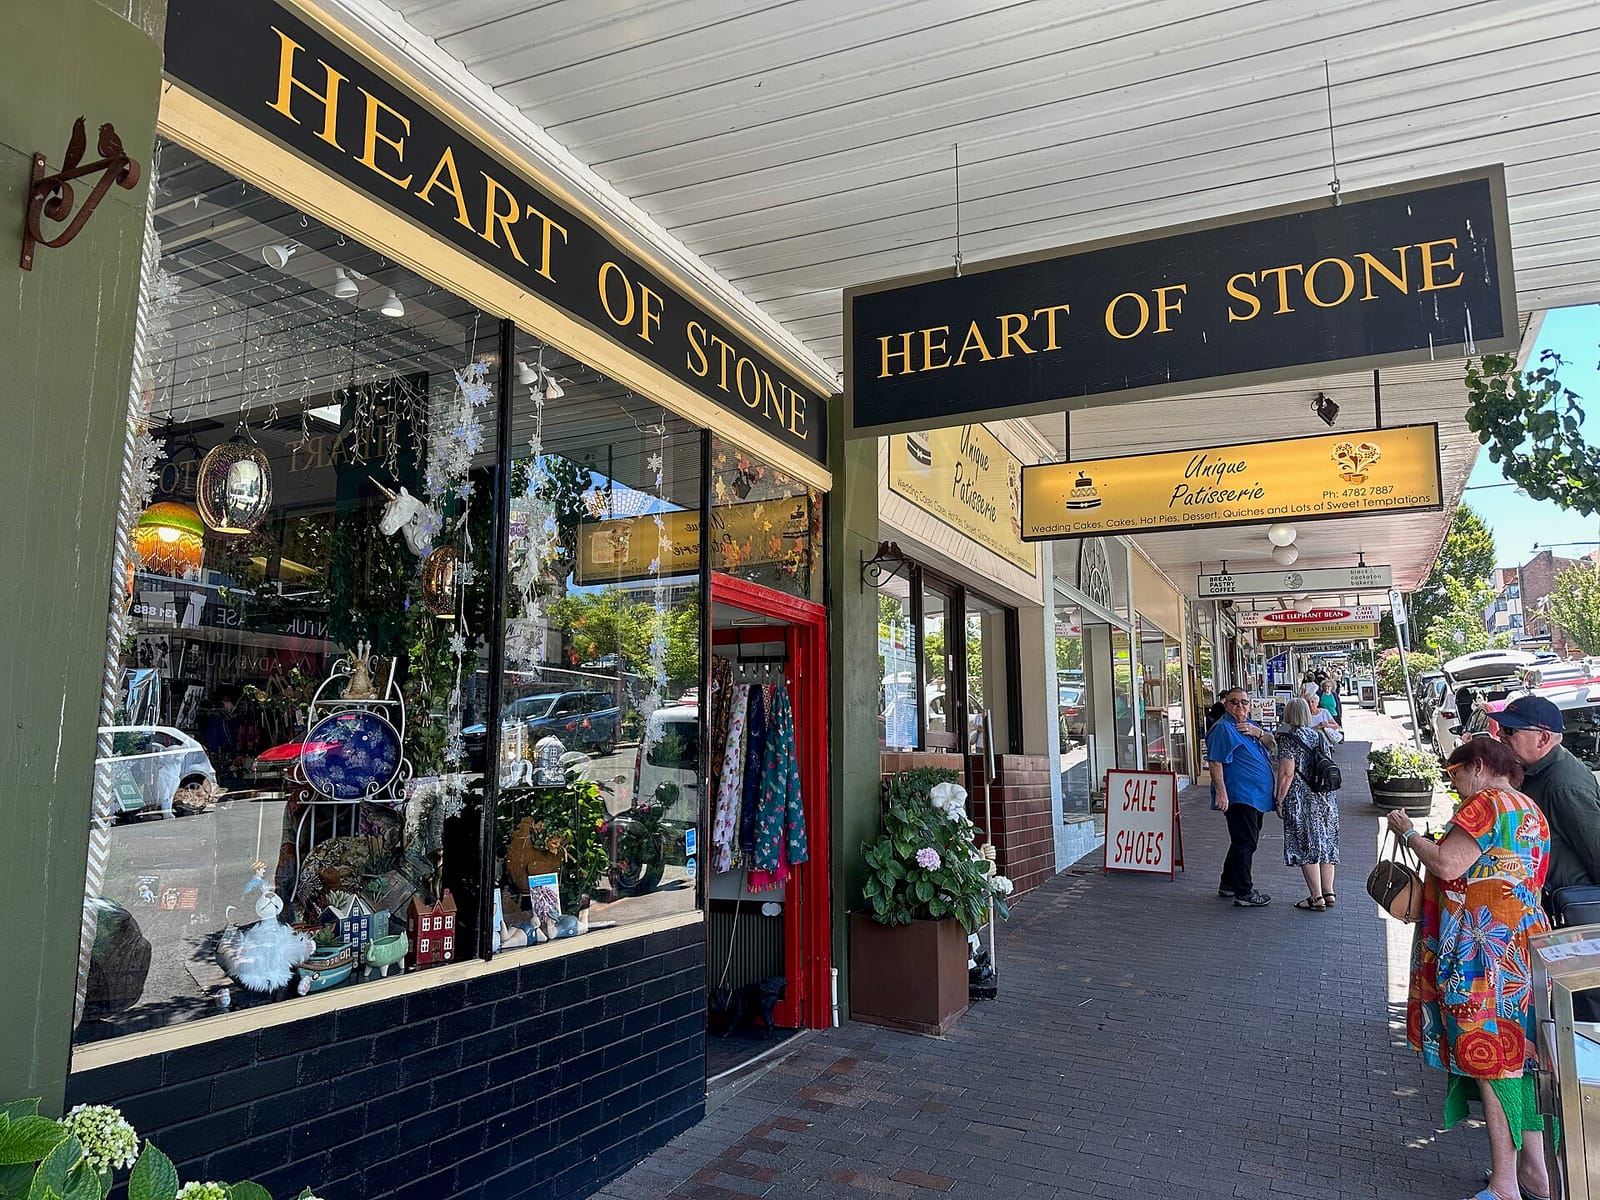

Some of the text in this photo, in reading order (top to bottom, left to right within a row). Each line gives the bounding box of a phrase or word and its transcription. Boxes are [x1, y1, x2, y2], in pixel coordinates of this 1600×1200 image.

[265, 25, 809, 440] HEART OF STONE
[876, 237, 1465, 379] HEART OF STONE
[960, 424, 990, 481] Unique
[1184, 454, 1247, 485] Unique
[952, 460, 997, 523] Patisserie
[1168, 481, 1265, 508] Patisserie
[1322, 485, 1394, 499] Ph: 4782 7887
[1031, 494, 1431, 533] Wedding Cakes, Cakes, Hot Pies, Dessert, Quiches and Lots of Sweet Temptations
[1286, 611, 1321, 620] ELEPHANT
[1323, 610, 1344, 618] BEAN
[1123, 779, 1158, 812] SALE
[1115, 830, 1164, 866] SHOES
